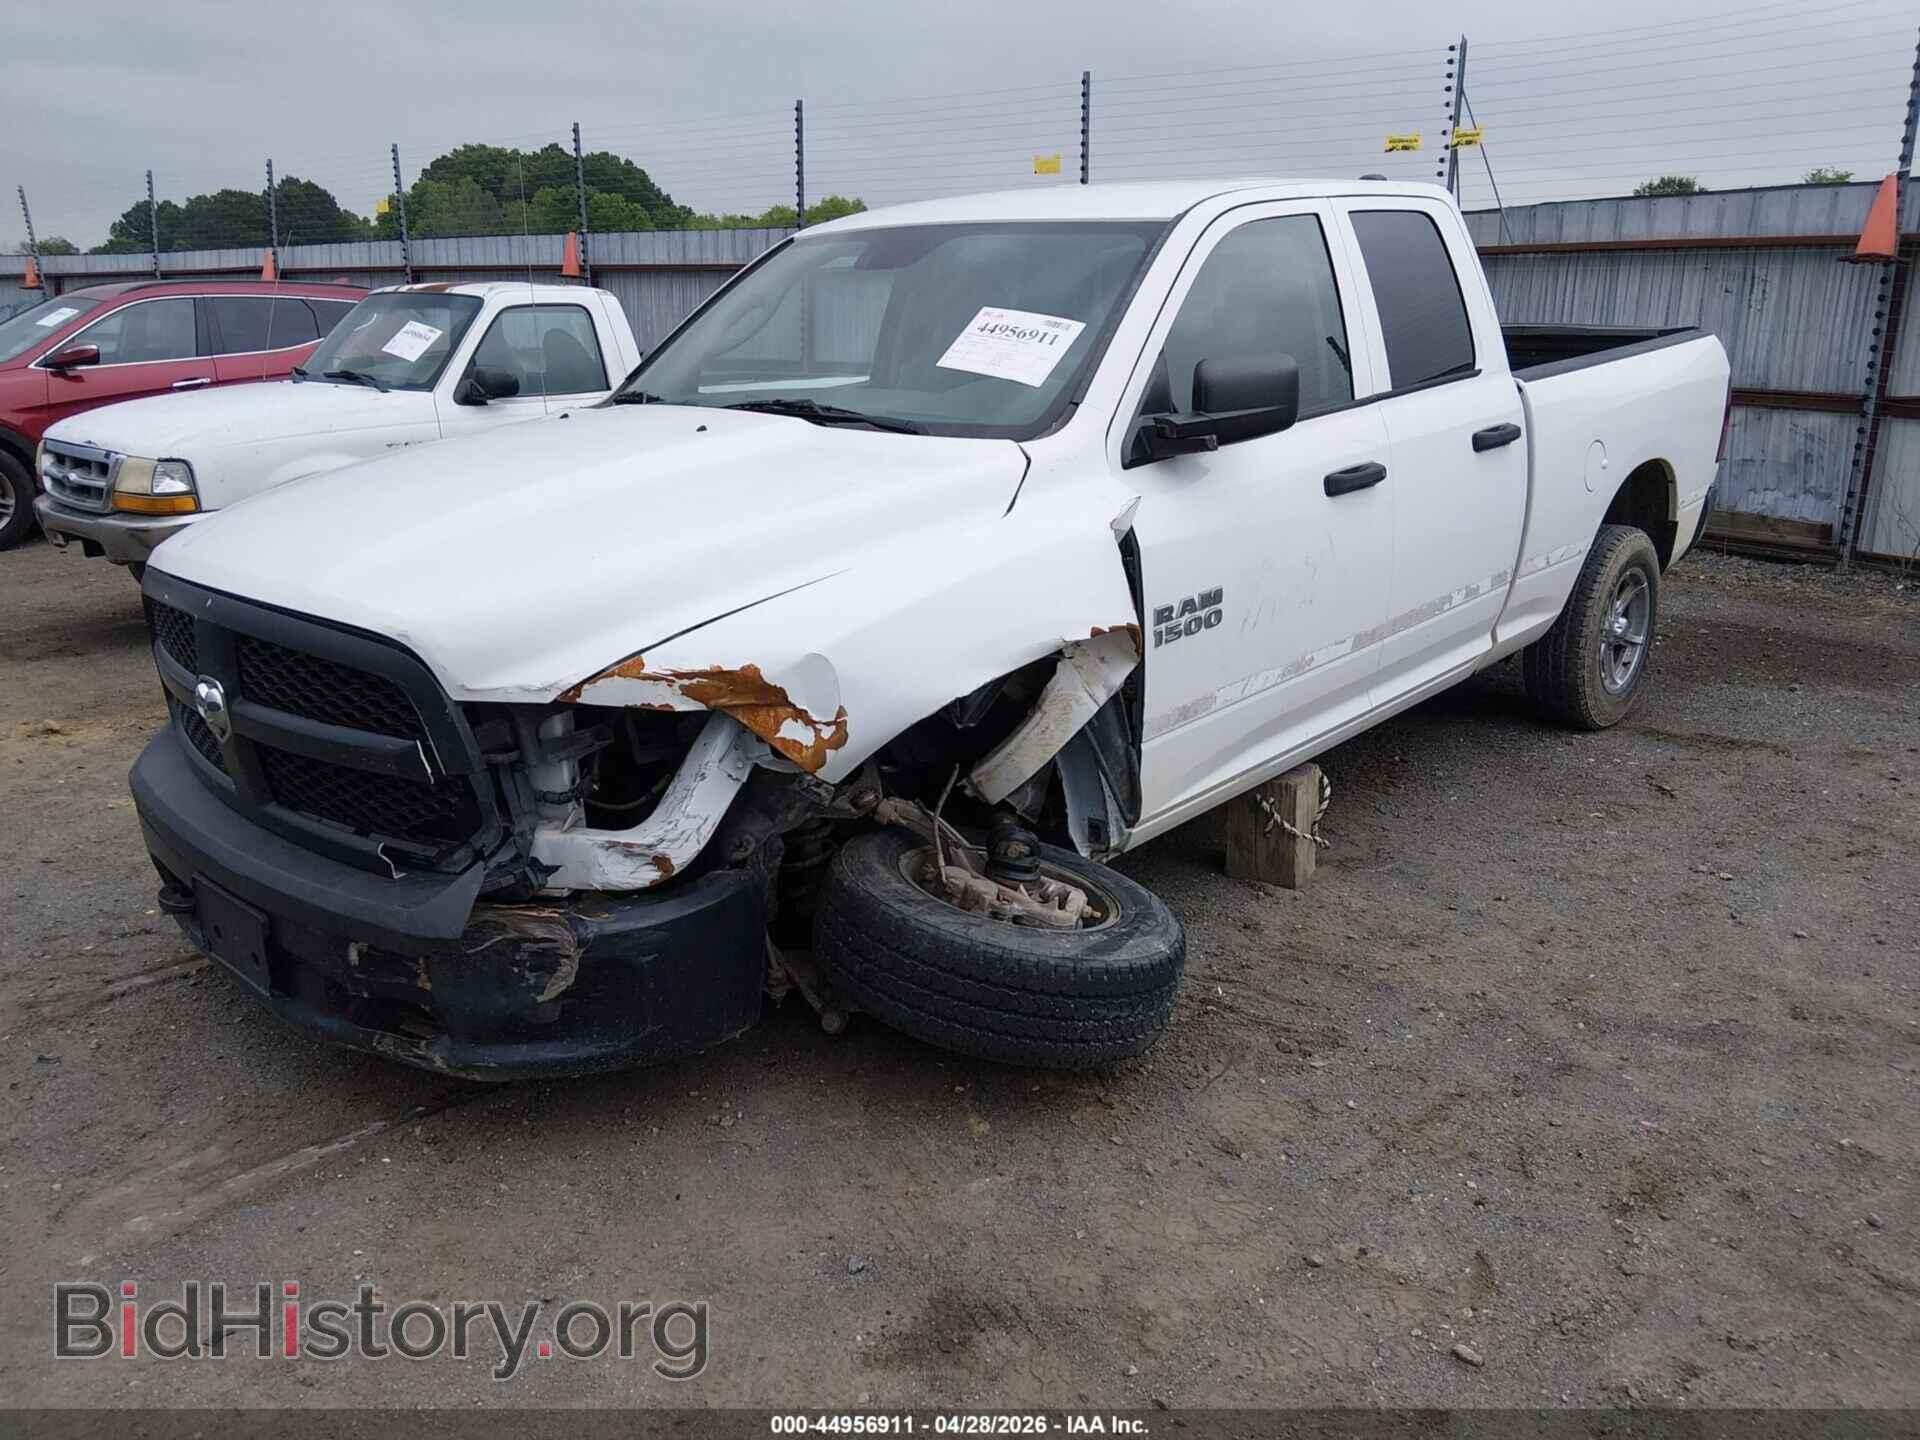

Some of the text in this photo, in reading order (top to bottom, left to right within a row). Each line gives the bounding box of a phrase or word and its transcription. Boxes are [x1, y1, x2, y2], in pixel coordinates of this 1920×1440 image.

[977, 321, 1059, 346] 44956911
[1153, 587, 1223, 627] RAM
[1153, 608, 1223, 648] 1500
